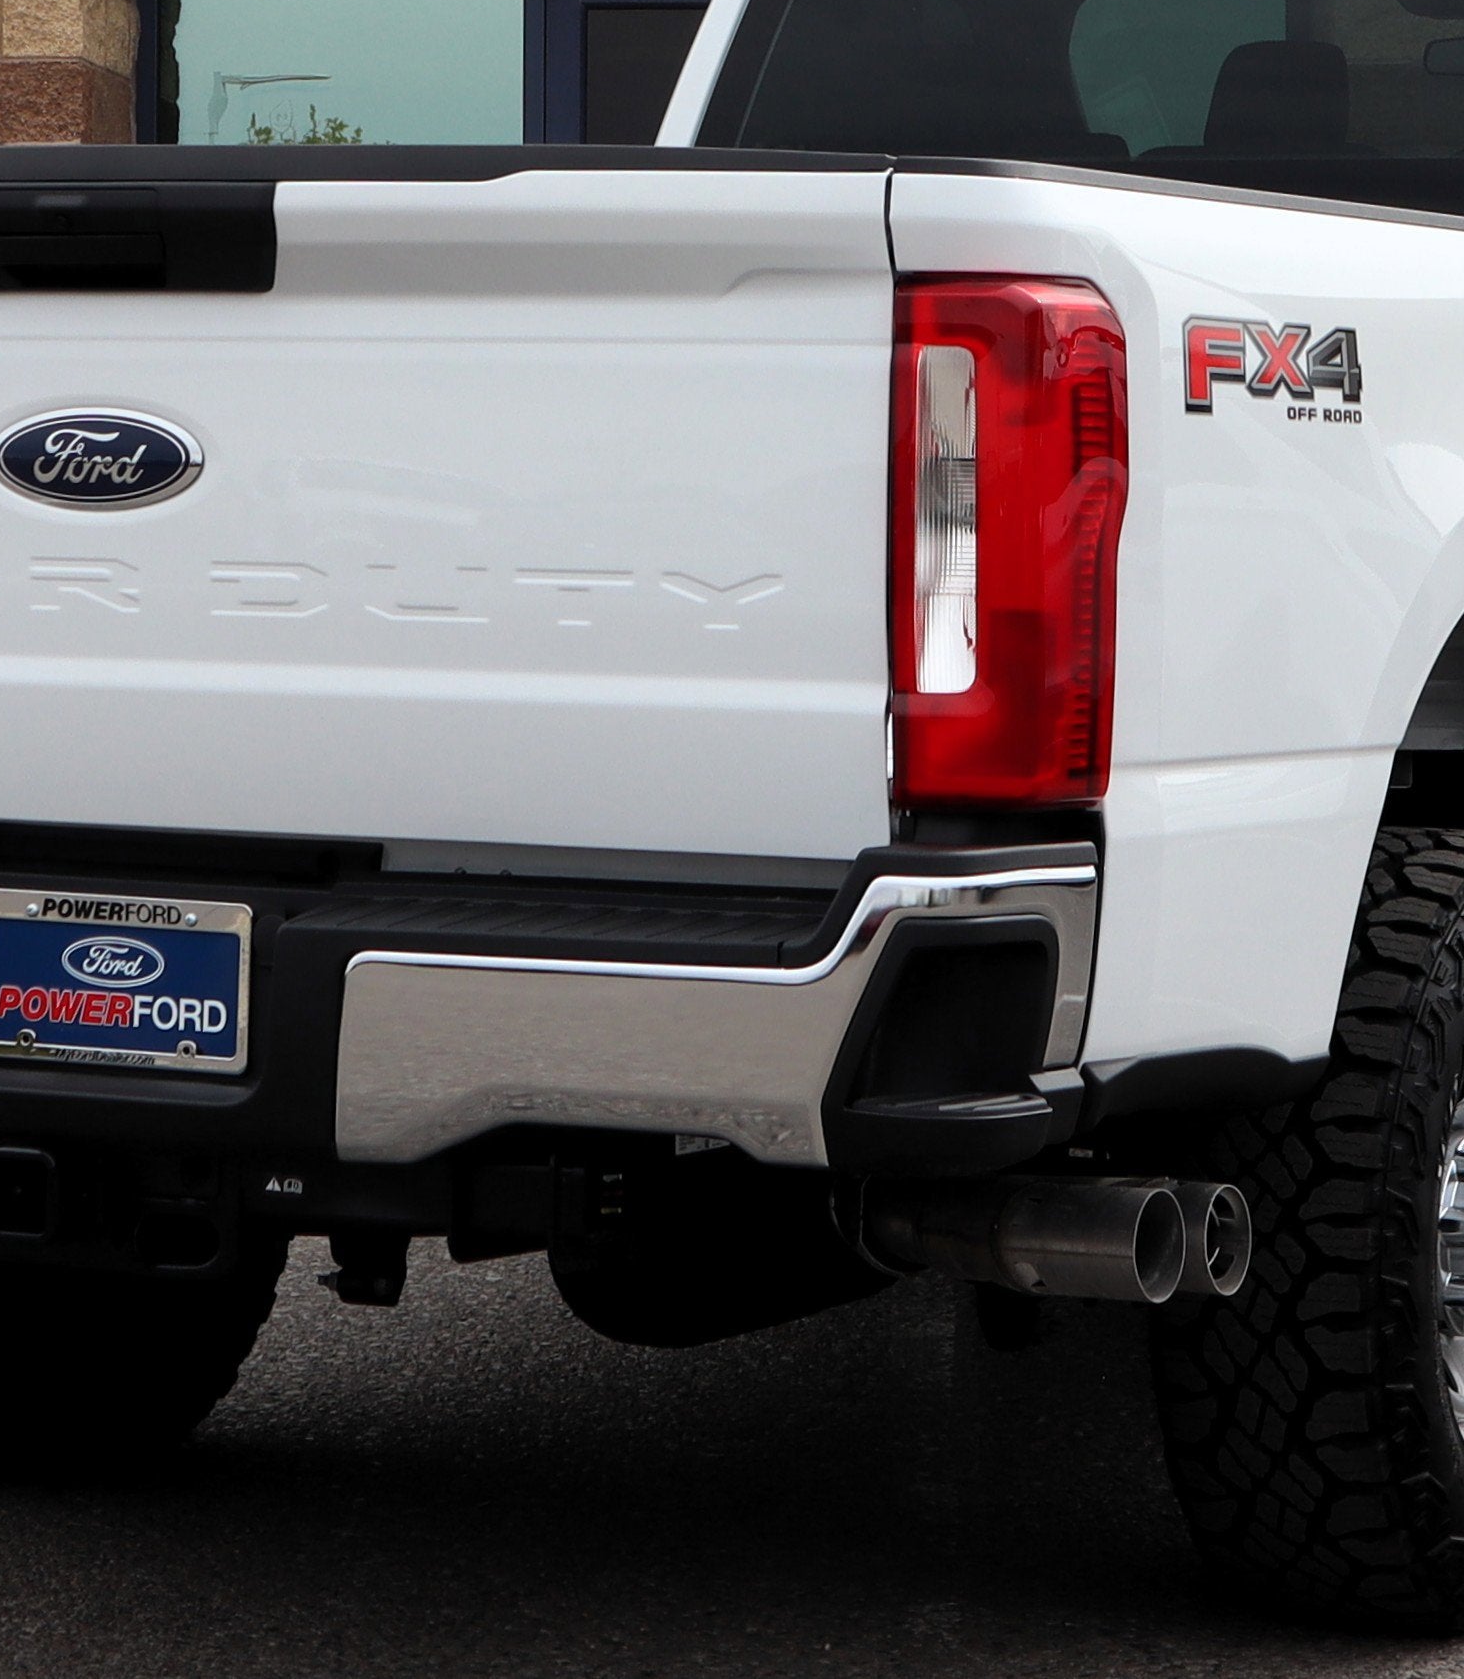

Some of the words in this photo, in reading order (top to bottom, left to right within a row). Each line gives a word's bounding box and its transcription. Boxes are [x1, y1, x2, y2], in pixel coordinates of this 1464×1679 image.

[1182, 314, 1364, 415] FX4
[1287, 406, 1318, 422] OFF
[1323, 408, 1363, 424] ROAD
[33, 428, 148, 484] Ford
[209, 559, 785, 630] DUTY
[41, 898, 183, 926] POWERFORD
[82, 943, 144, 978] Ford
